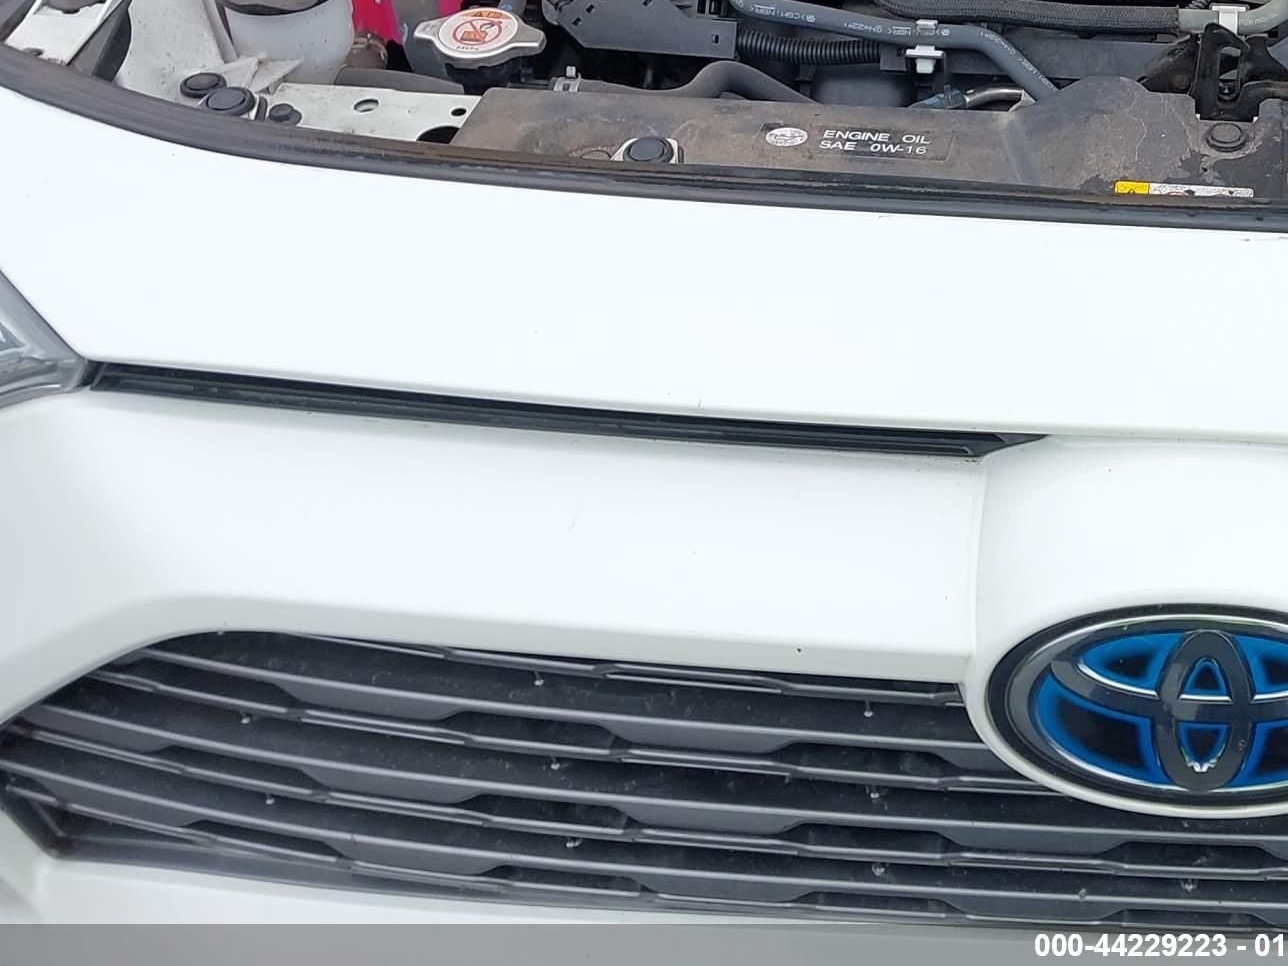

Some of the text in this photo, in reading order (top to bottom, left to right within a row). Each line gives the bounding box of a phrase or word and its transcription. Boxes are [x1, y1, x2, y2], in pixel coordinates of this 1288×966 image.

[822, 129, 891, 143] ENGINE
[901, 134, 931, 145] OIL
[819, 139, 928, 155] SAE 0W-16
